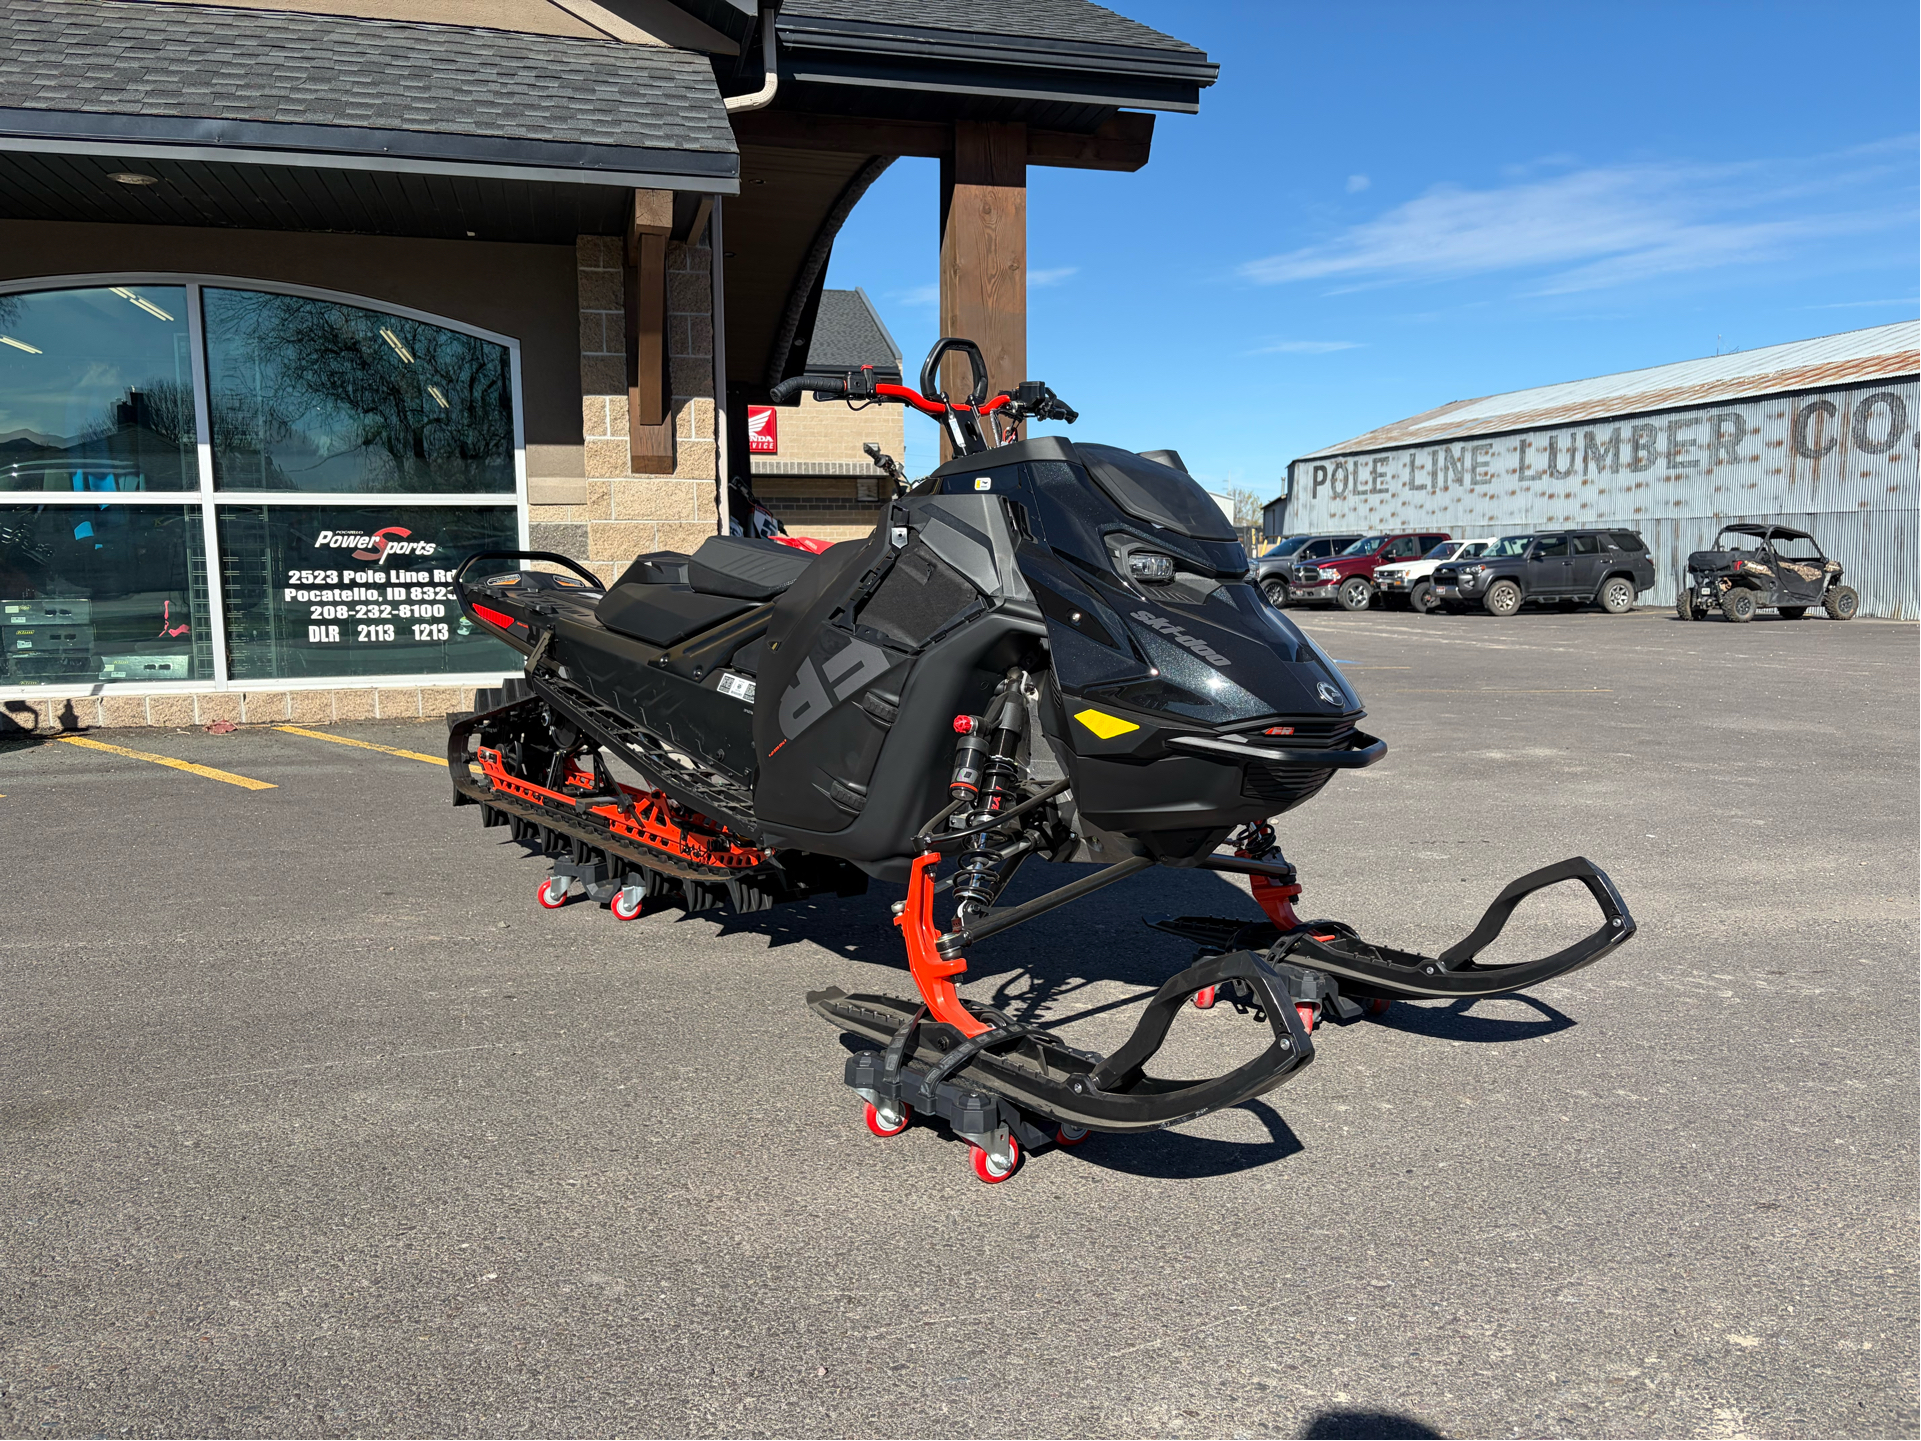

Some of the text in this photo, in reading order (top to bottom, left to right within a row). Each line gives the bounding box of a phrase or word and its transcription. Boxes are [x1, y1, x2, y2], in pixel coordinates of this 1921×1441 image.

[1312, 455, 1390, 499] POLE
[1408, 442, 1493, 491] LINE
[1518, 411, 1747, 482] LUMBER
[288, 570, 339, 584] 2523
[343, 570, 387, 584] Pole
[390, 569, 430, 583] Line
[284, 588, 383, 602] Pocatello,
[386, 587, 406, 600] ID
[310, 604, 445, 619] 208-232-8100
[308, 623, 449, 642] DLR 2113 1213
